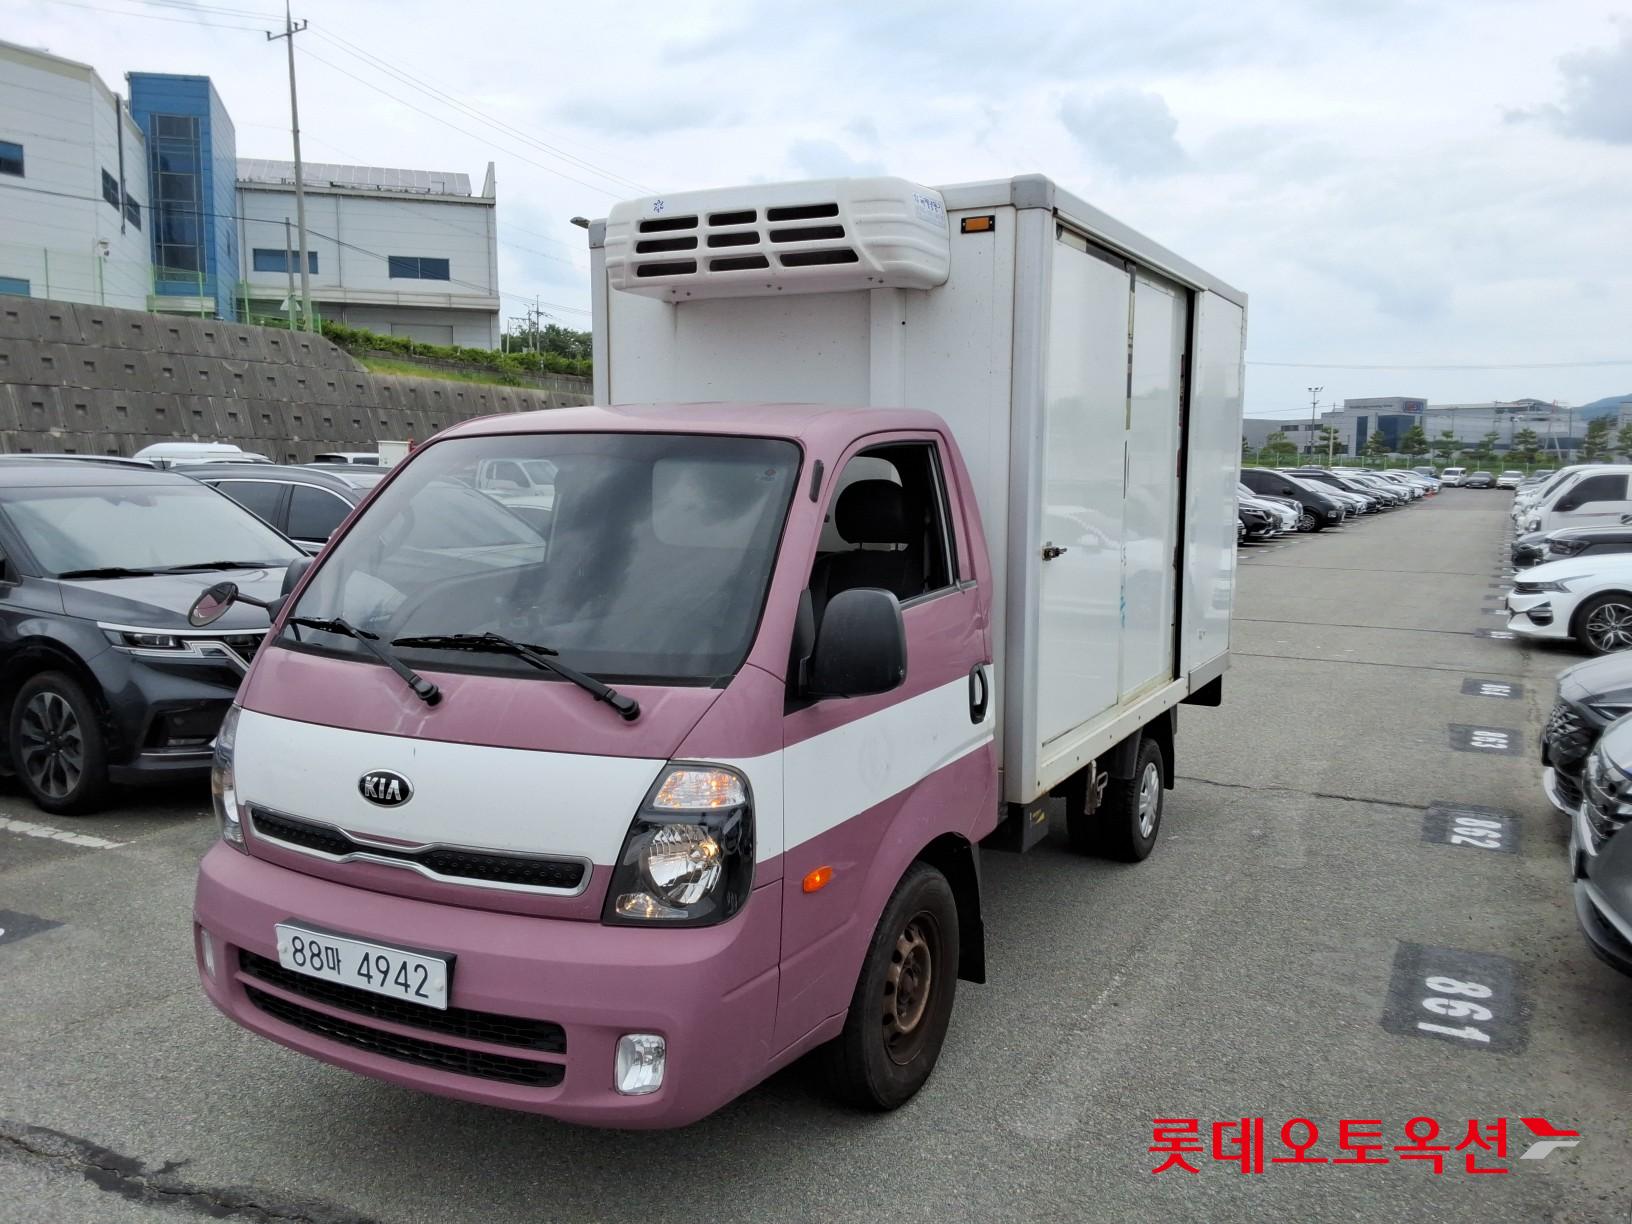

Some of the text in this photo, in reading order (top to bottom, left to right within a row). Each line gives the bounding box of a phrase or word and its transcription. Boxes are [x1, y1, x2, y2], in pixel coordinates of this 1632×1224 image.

[1470, 730, 1508, 749] 863
[364, 776, 402, 801] KIA
[1450, 816, 1503, 849] 862
[291, 935, 430, 999] 88마 4942
[1417, 975, 1494, 1043] 861
